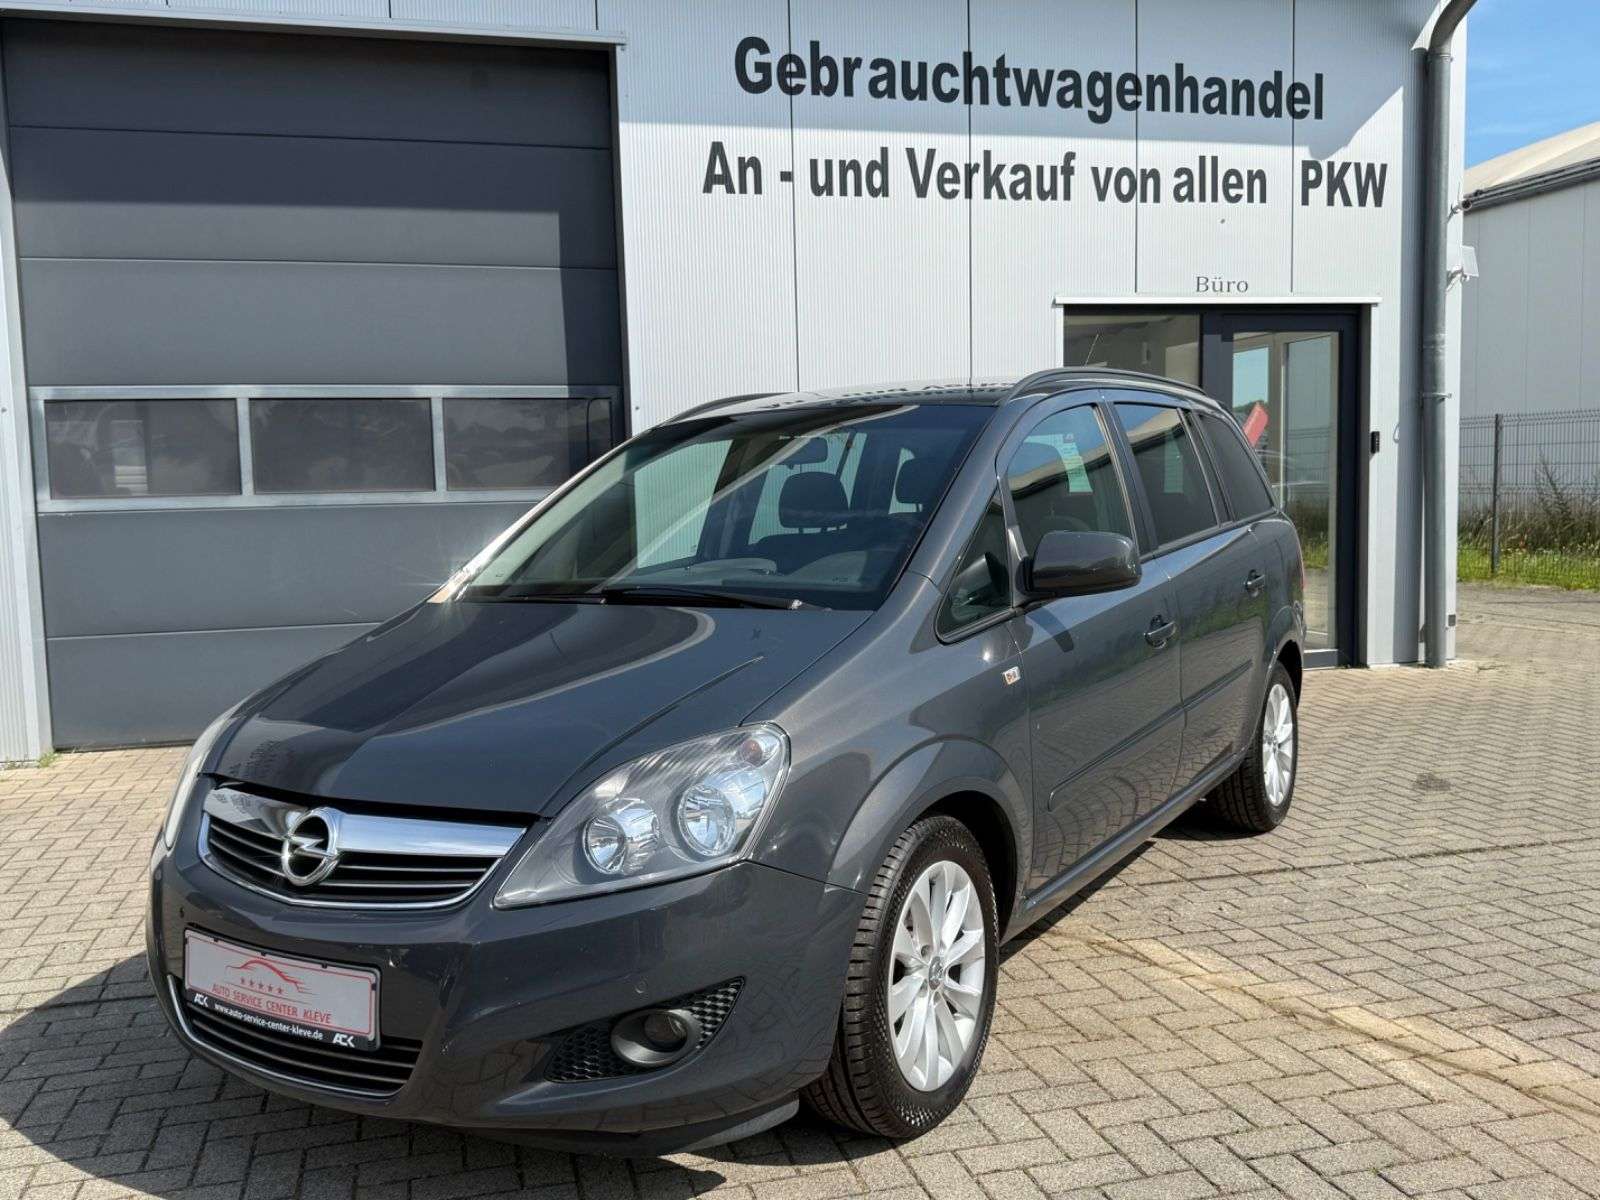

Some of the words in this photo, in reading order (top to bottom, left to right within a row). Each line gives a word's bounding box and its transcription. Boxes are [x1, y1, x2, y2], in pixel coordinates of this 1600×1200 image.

[735, 37, 1325, 124] Gebrauchtwagenhandel
[703, 142, 764, 196] An
[780, 171, 794, 183] -
[810, 147, 890, 199] und
[907, 149, 1077, 202] Verkauf
[1092, 167, 1163, 204] von
[1174, 156, 1268, 205] allen
[1302, 161, 1388, 209] PKW
[1195, 275, 1249, 293] Büro
[212, 983, 231, 999] AUTO
[233, 989, 263, 1009] SERVICE
[265, 1000, 298, 1017] CENTER
[302, 1008, 332, 1024] KLEVE
[214, 1003, 324, 1041] www.auto-service-center-kleve.de
